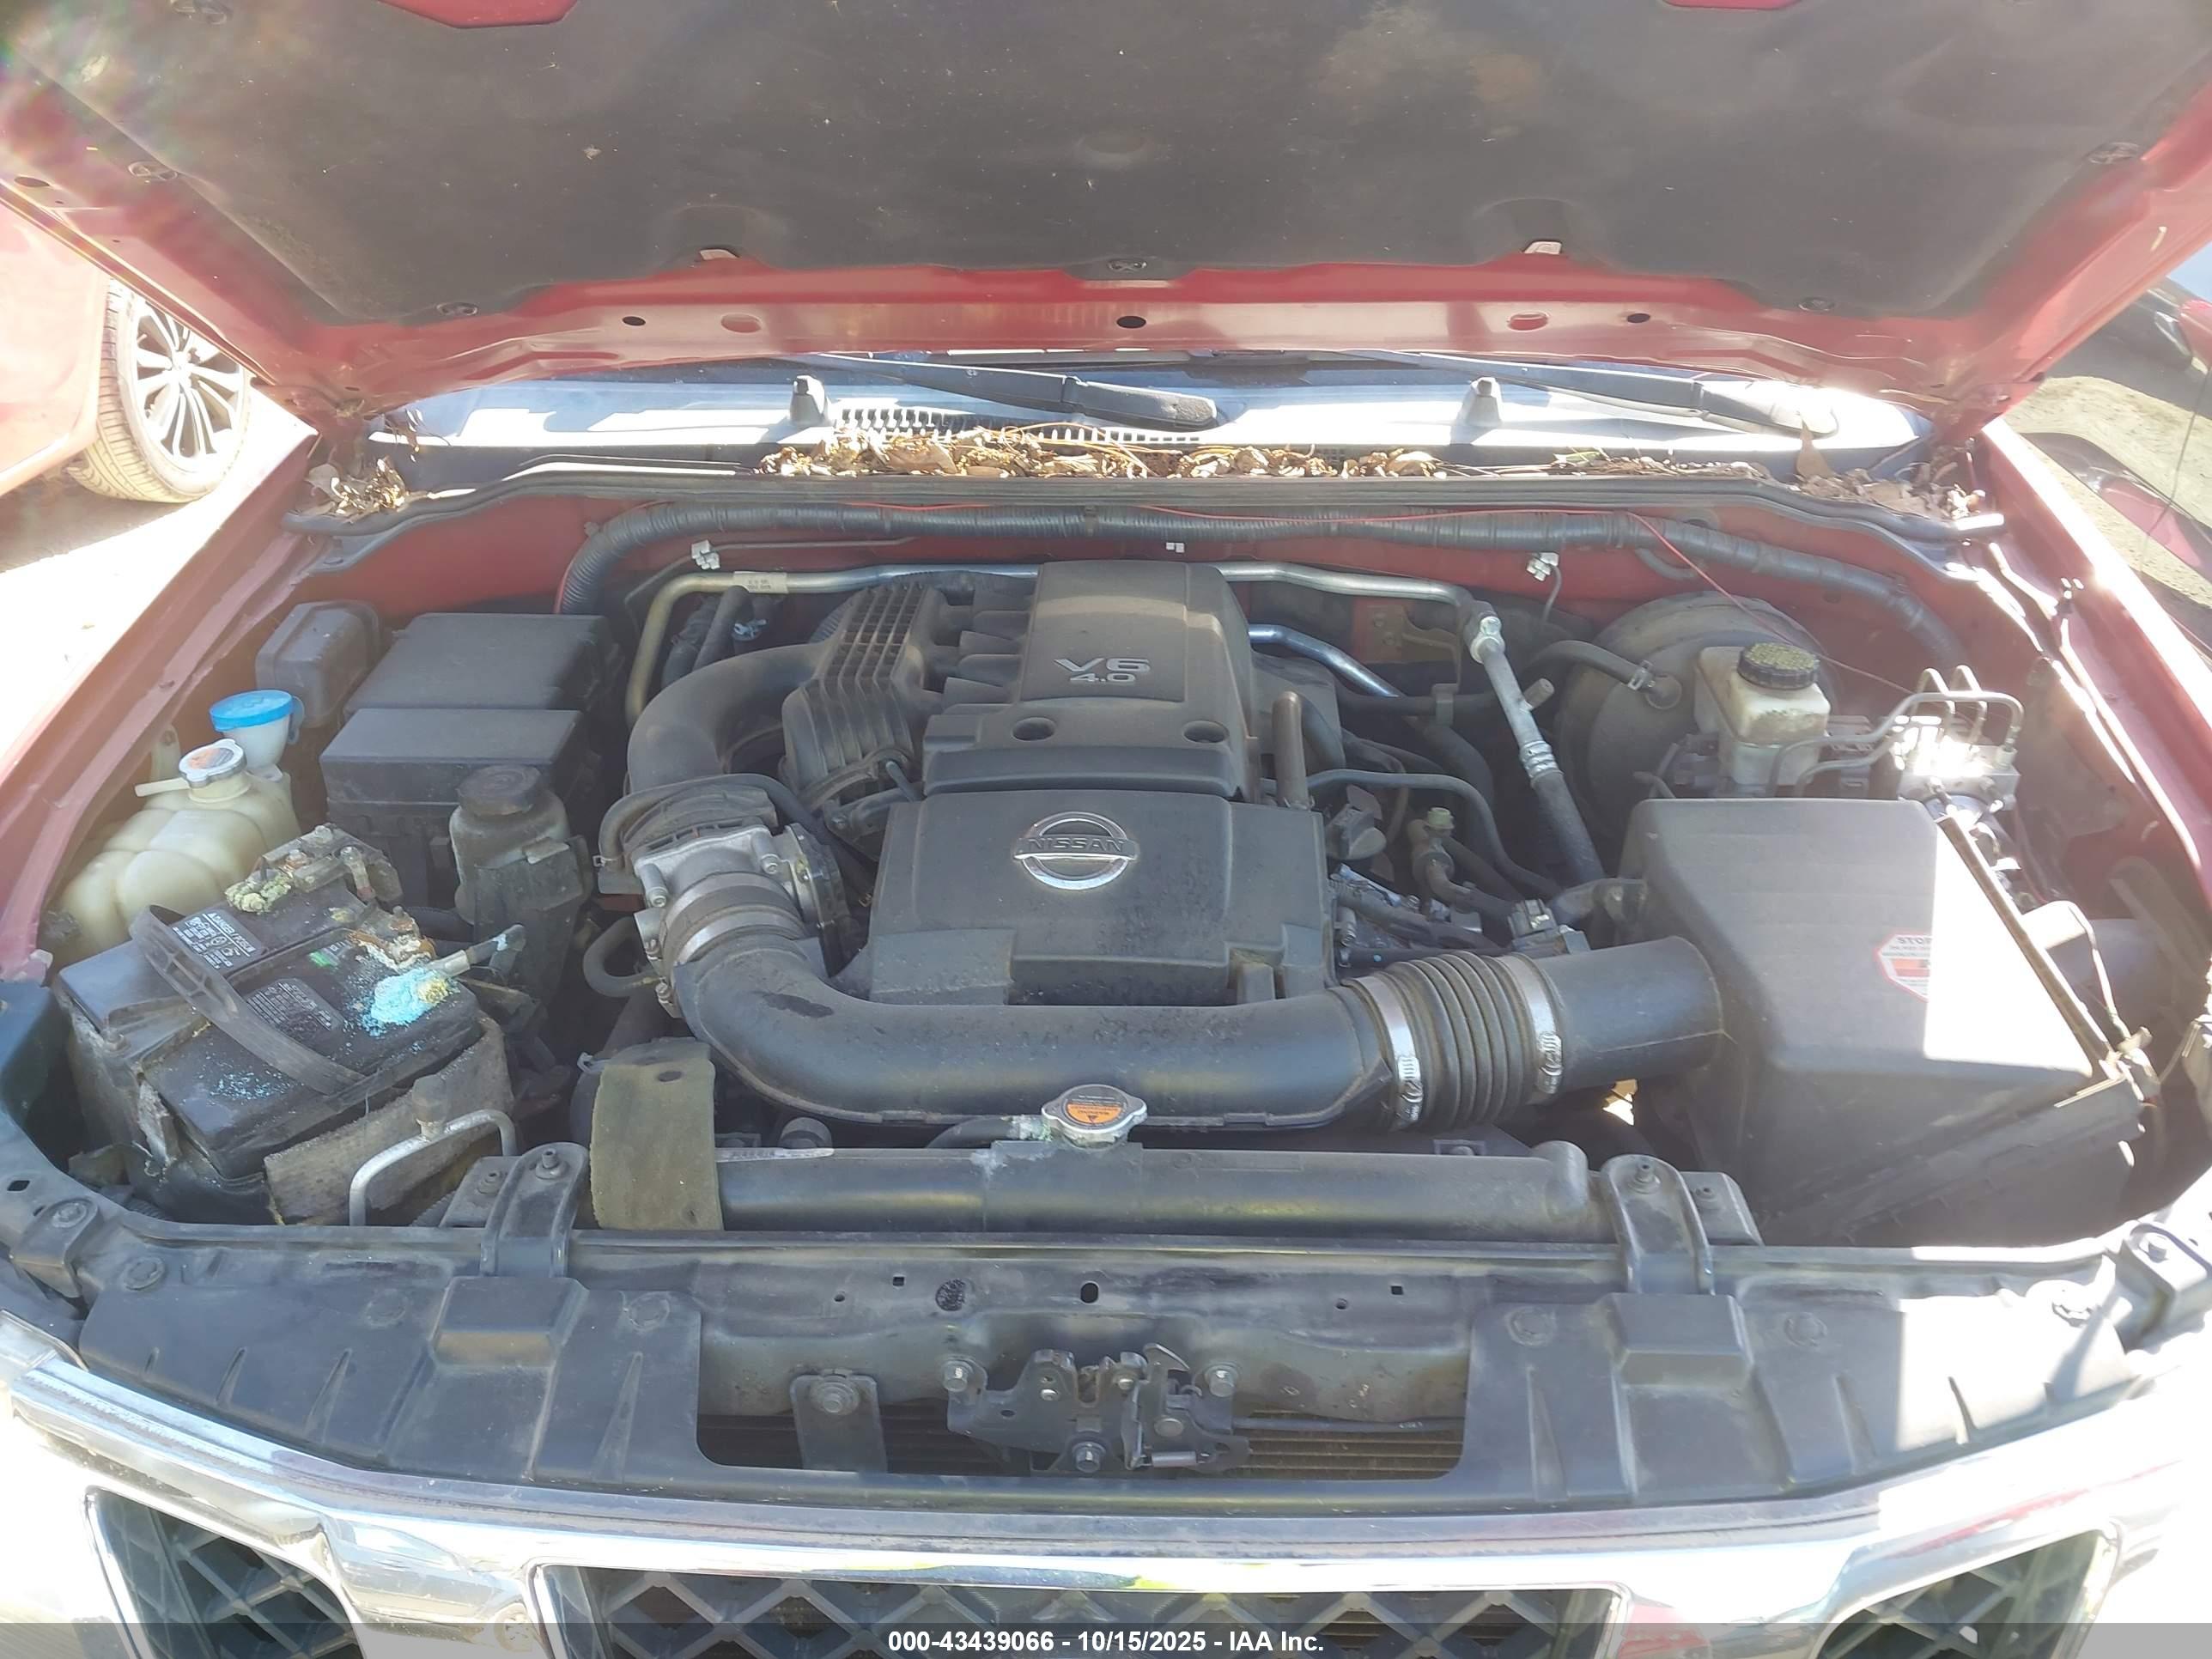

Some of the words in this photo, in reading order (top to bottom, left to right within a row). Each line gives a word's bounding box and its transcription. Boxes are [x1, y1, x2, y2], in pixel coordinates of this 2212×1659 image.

[1054, 657, 1151, 673] V6
[1069, 672, 1136, 683] 4.0
[1027, 837, 1125, 852] NISSAN
